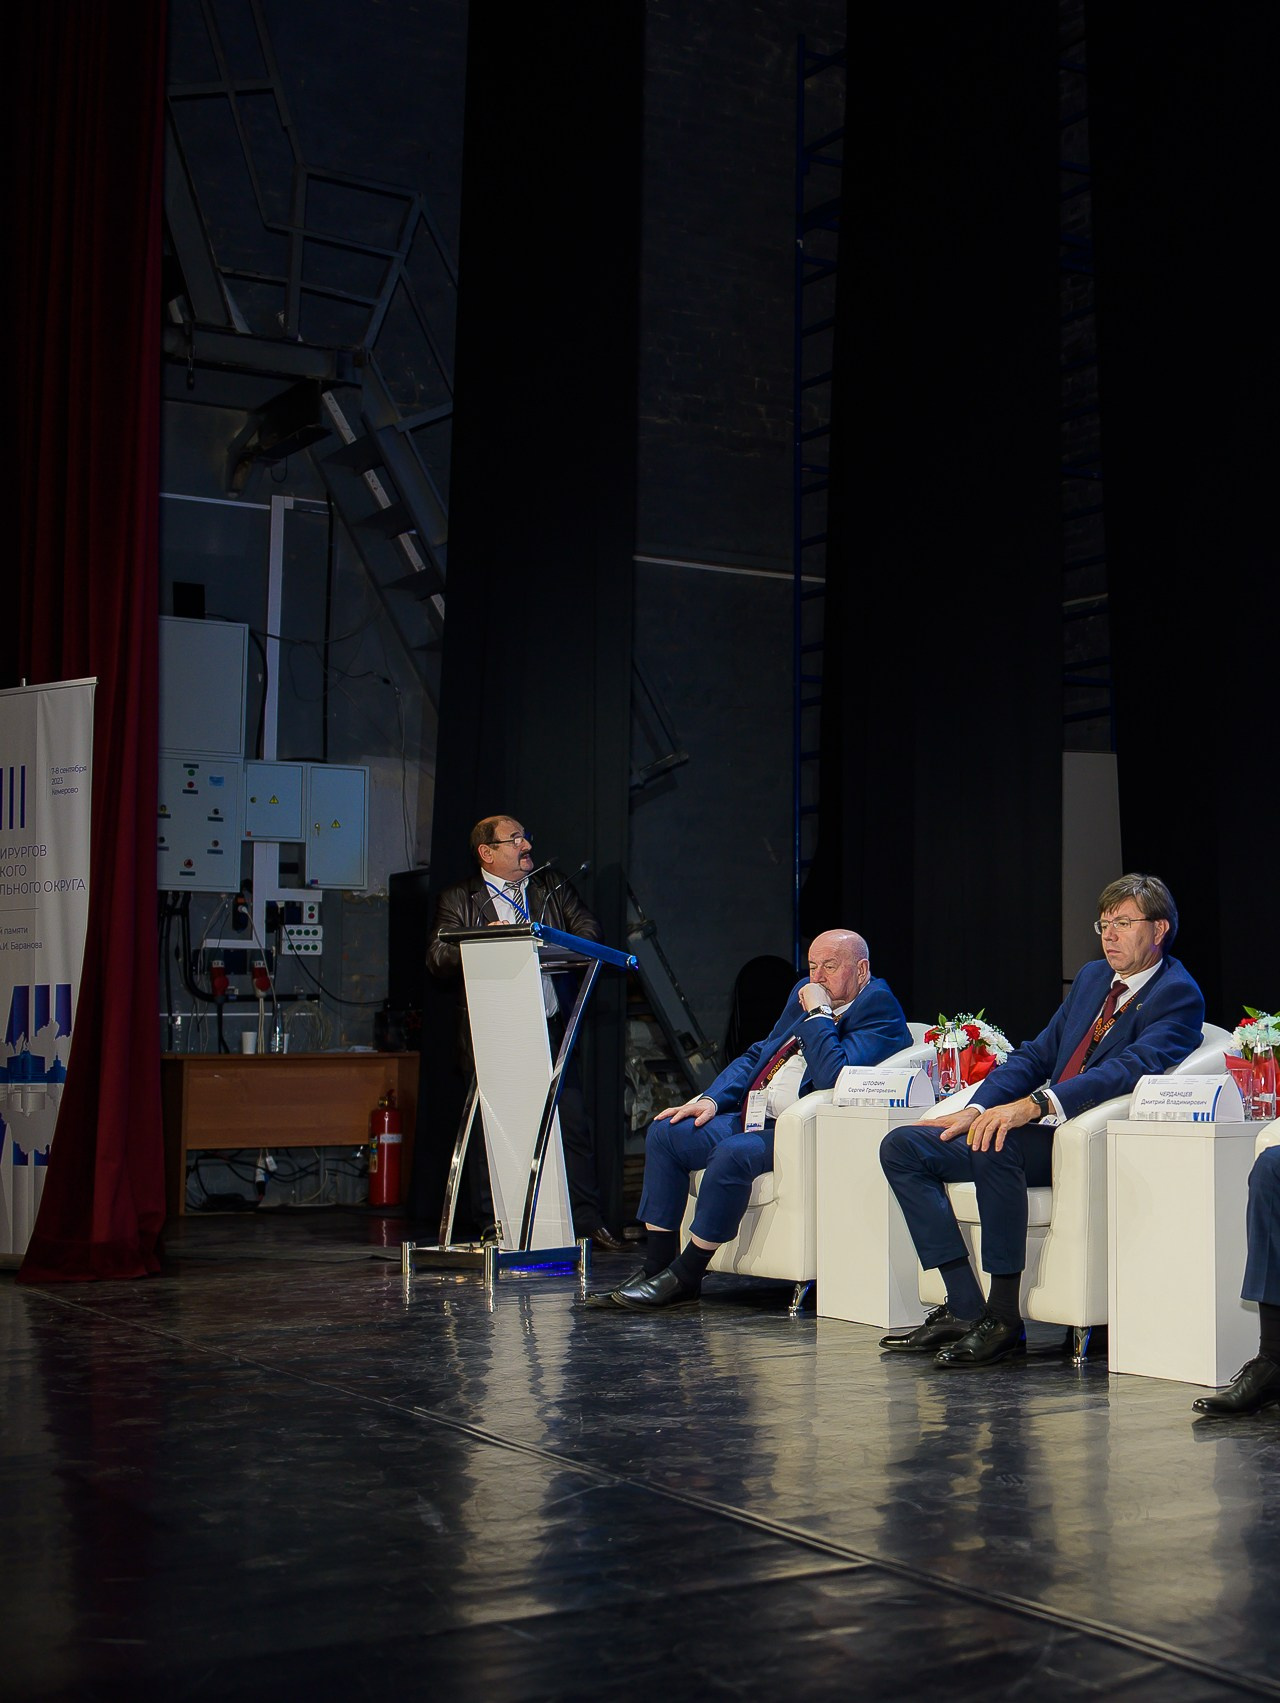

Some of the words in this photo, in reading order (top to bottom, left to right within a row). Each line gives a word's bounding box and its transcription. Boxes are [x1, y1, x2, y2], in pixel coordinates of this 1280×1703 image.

[51, 787, 79, 796] Кемерово
[44, 878, 86, 893] ОКРУГА
[4, 927, 28, 935] памяти
[766, 1057, 785, 1081] BOWA
